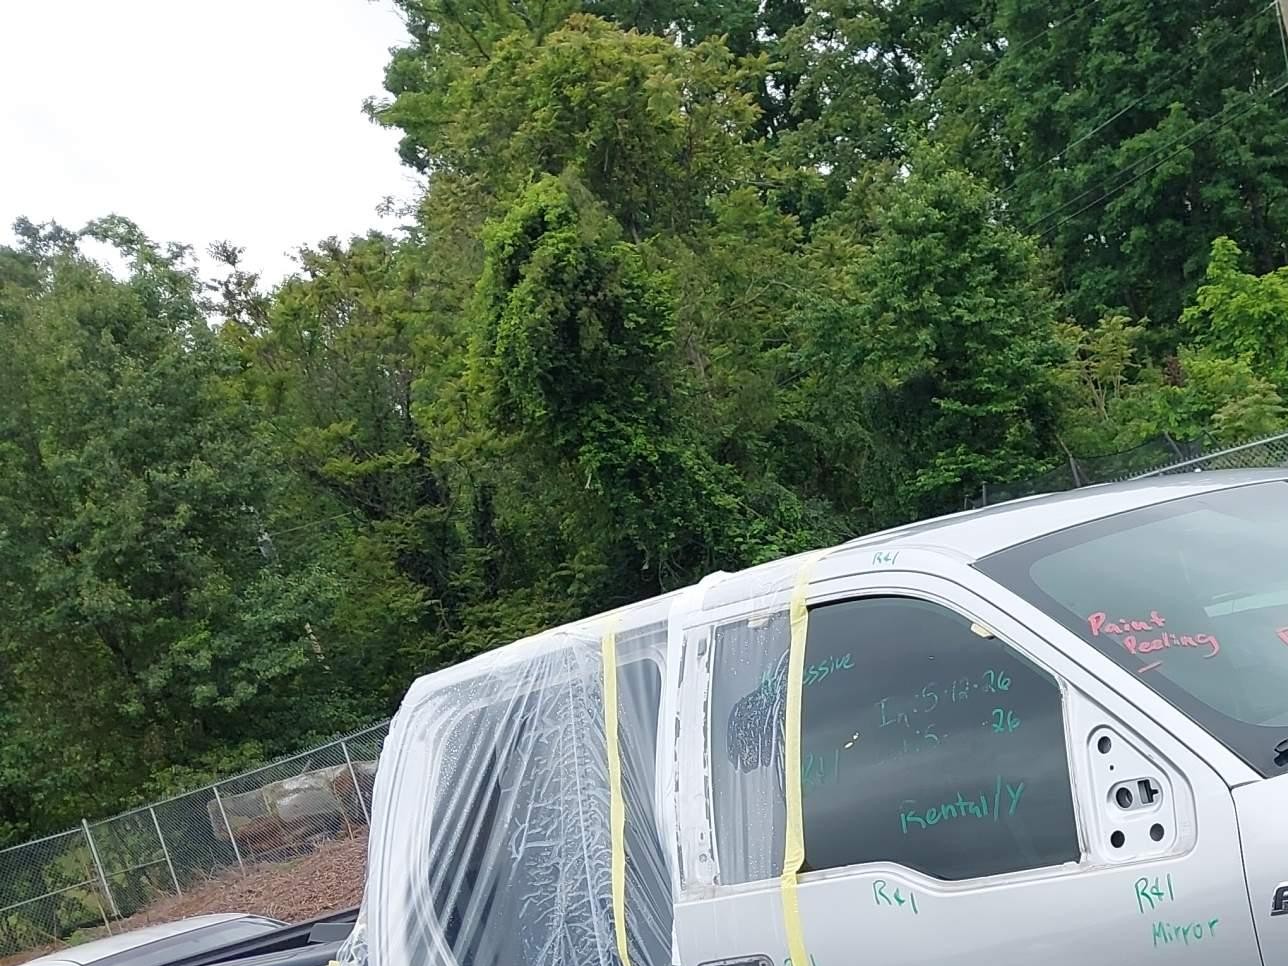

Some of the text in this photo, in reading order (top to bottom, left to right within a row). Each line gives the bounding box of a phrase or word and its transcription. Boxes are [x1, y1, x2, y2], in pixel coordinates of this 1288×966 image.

[1087, 610, 1166, 636] Paint
[1123, 632, 1220, 660] Peeling
[1151, 918, 1220, 949] Mirror
